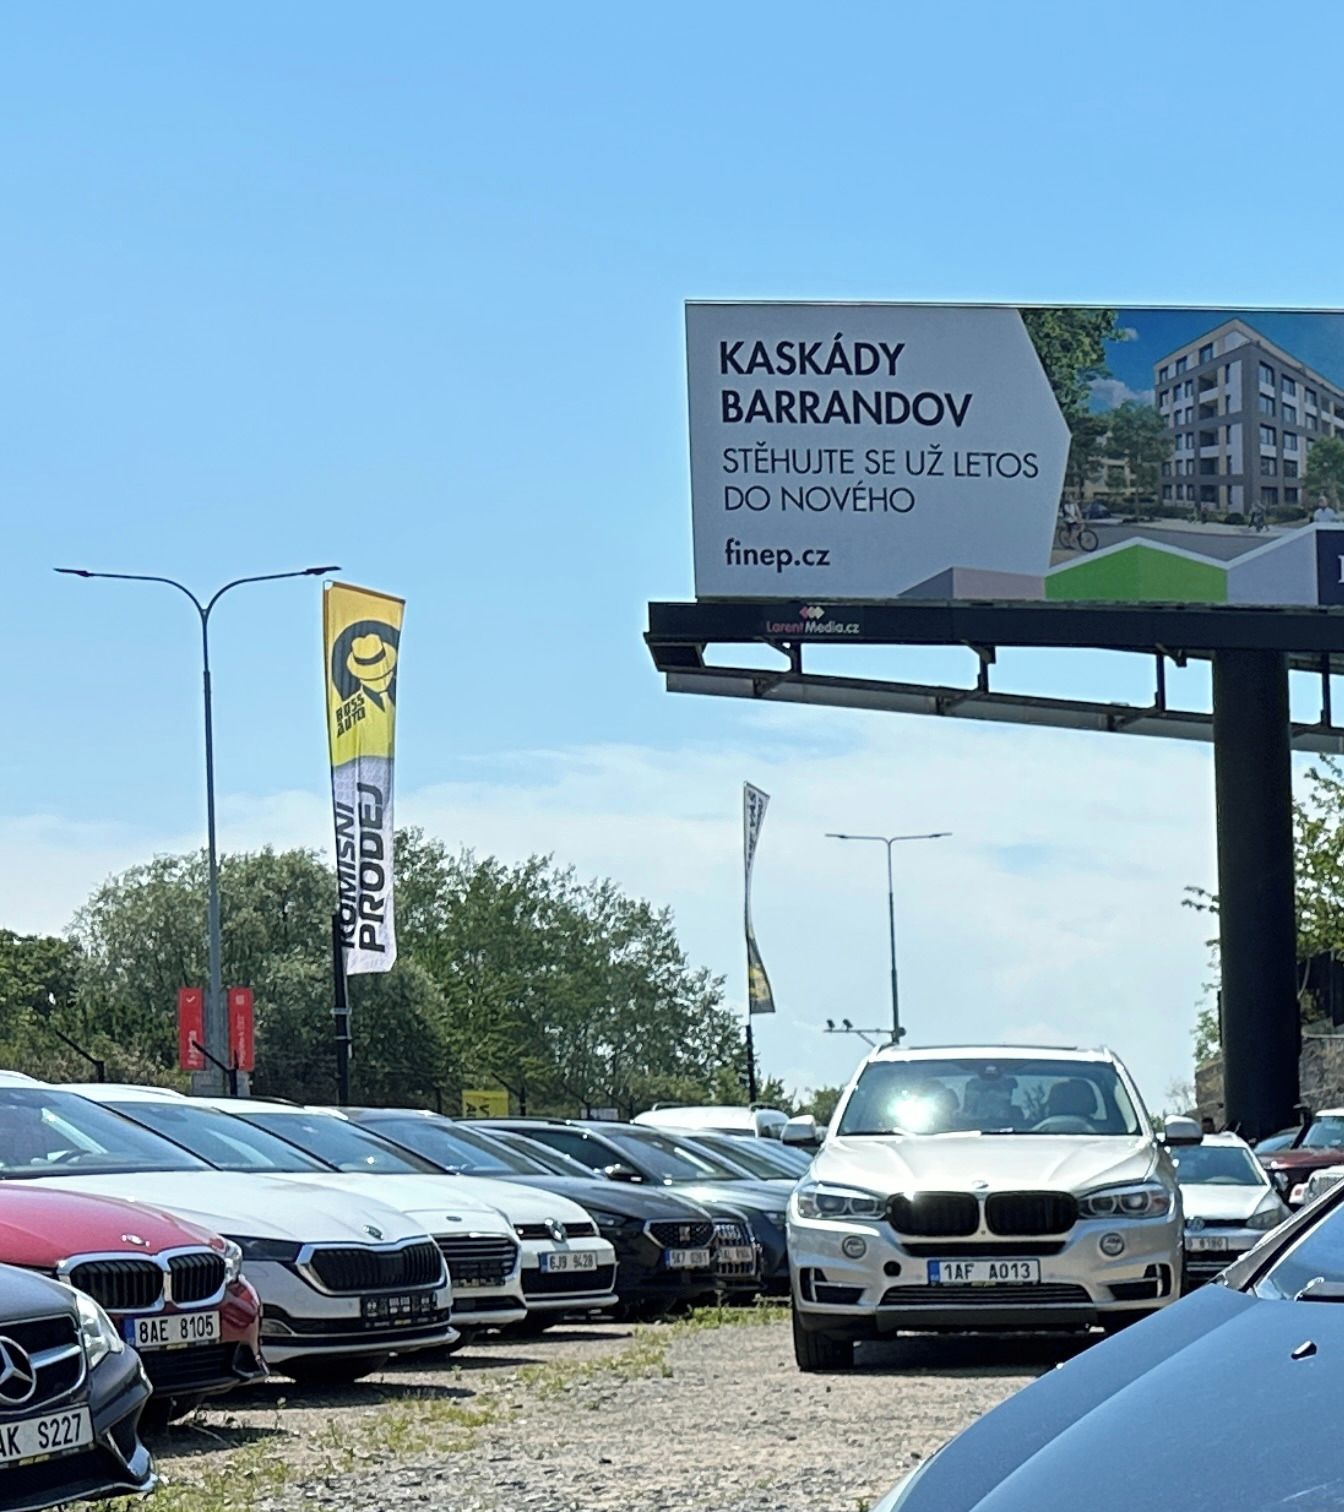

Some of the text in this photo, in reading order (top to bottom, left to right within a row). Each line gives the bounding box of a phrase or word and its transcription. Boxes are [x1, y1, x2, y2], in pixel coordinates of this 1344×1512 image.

[720, 332, 906, 376] KASKÁDY
[721, 390, 973, 428] BARRANDOV
[723, 441, 1039, 478] STĚHUJTE SE UŽ LETOS
[724, 480, 915, 513] DO NOVÉHO
[725, 538, 831, 573] finep.cz
[336, 691, 365, 721] BOSS
[336, 708, 366, 738] AUTO
[357, 782, 386, 953] PRODEJ
[944, 1263, 1031, 1280] 1AF A013
[139, 1315, 214, 1343] 8AE 8105
[37, 1413, 81, 1449] S227
